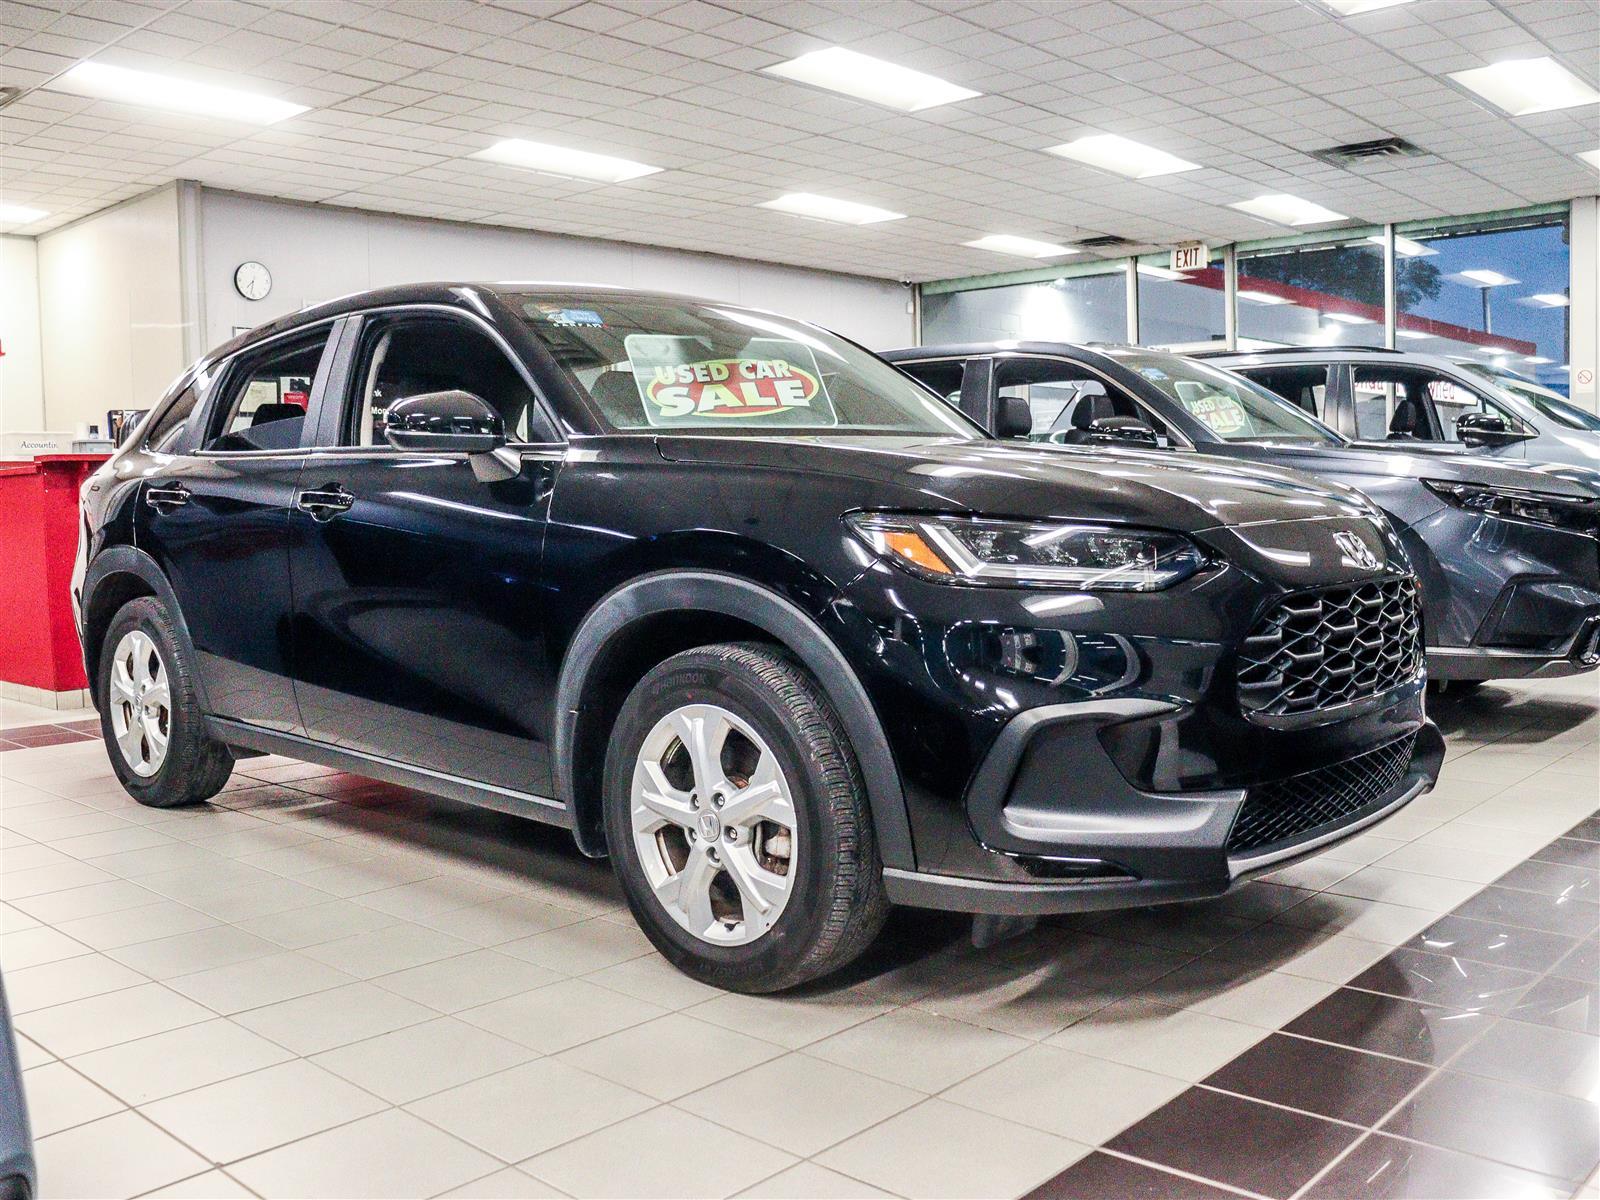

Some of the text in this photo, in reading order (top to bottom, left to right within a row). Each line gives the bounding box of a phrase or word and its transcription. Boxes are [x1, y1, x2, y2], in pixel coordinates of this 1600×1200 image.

[1176, 248, 1200, 268] EXIT
[654, 360, 793, 385] USED CAR
[656, 380, 811, 417] SALE
